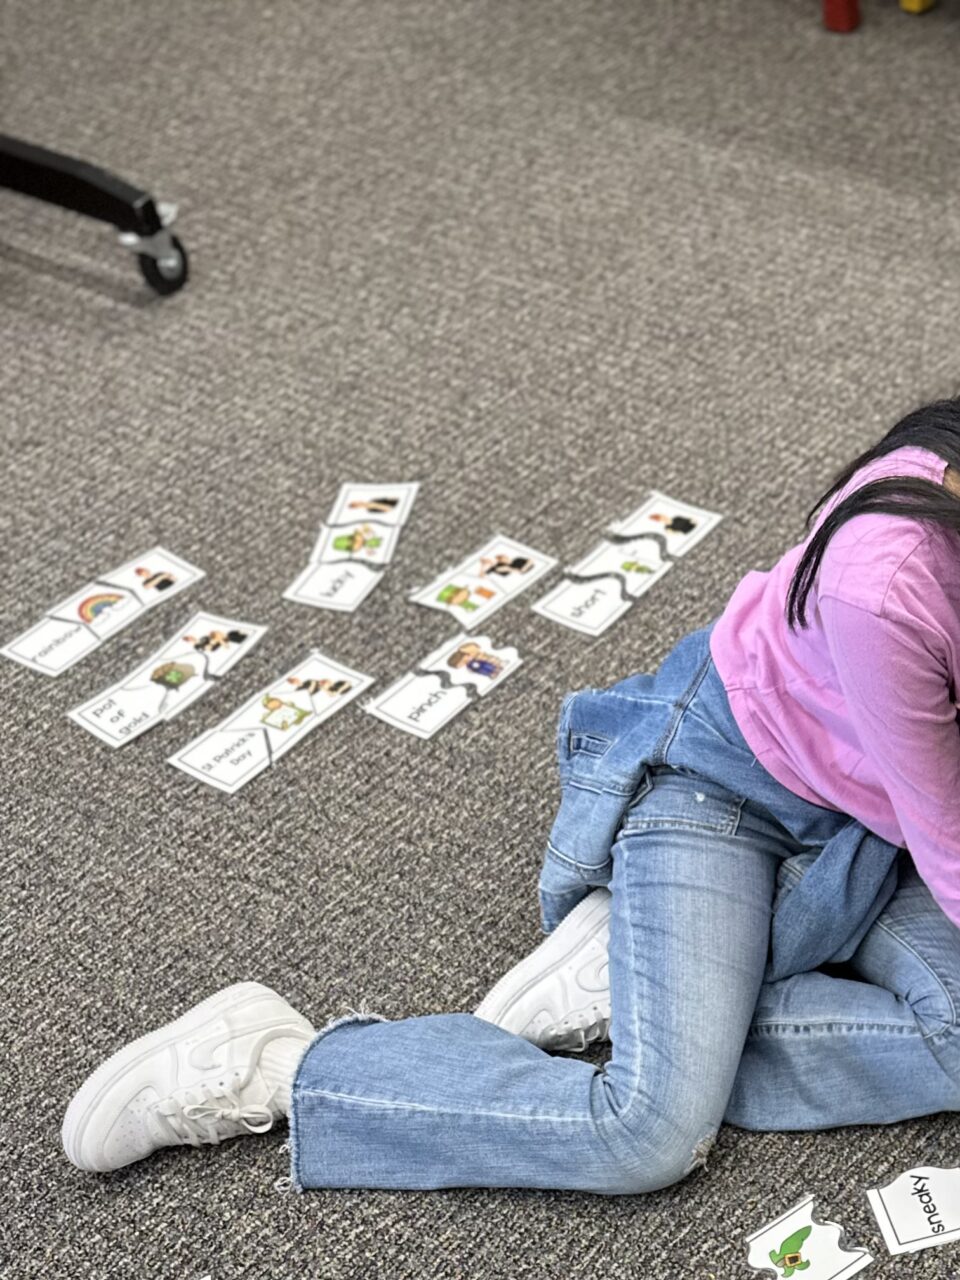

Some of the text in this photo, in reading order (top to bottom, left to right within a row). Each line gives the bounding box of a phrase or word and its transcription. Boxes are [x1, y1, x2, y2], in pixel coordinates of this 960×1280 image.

[92, 698, 117, 718] pot
[110, 709, 125, 723] of
[407, 690, 447, 722] pinch
[118, 712, 150, 735] gold
[229, 749, 253, 766] Day
[910, 1174, 945, 1234] sneaky
